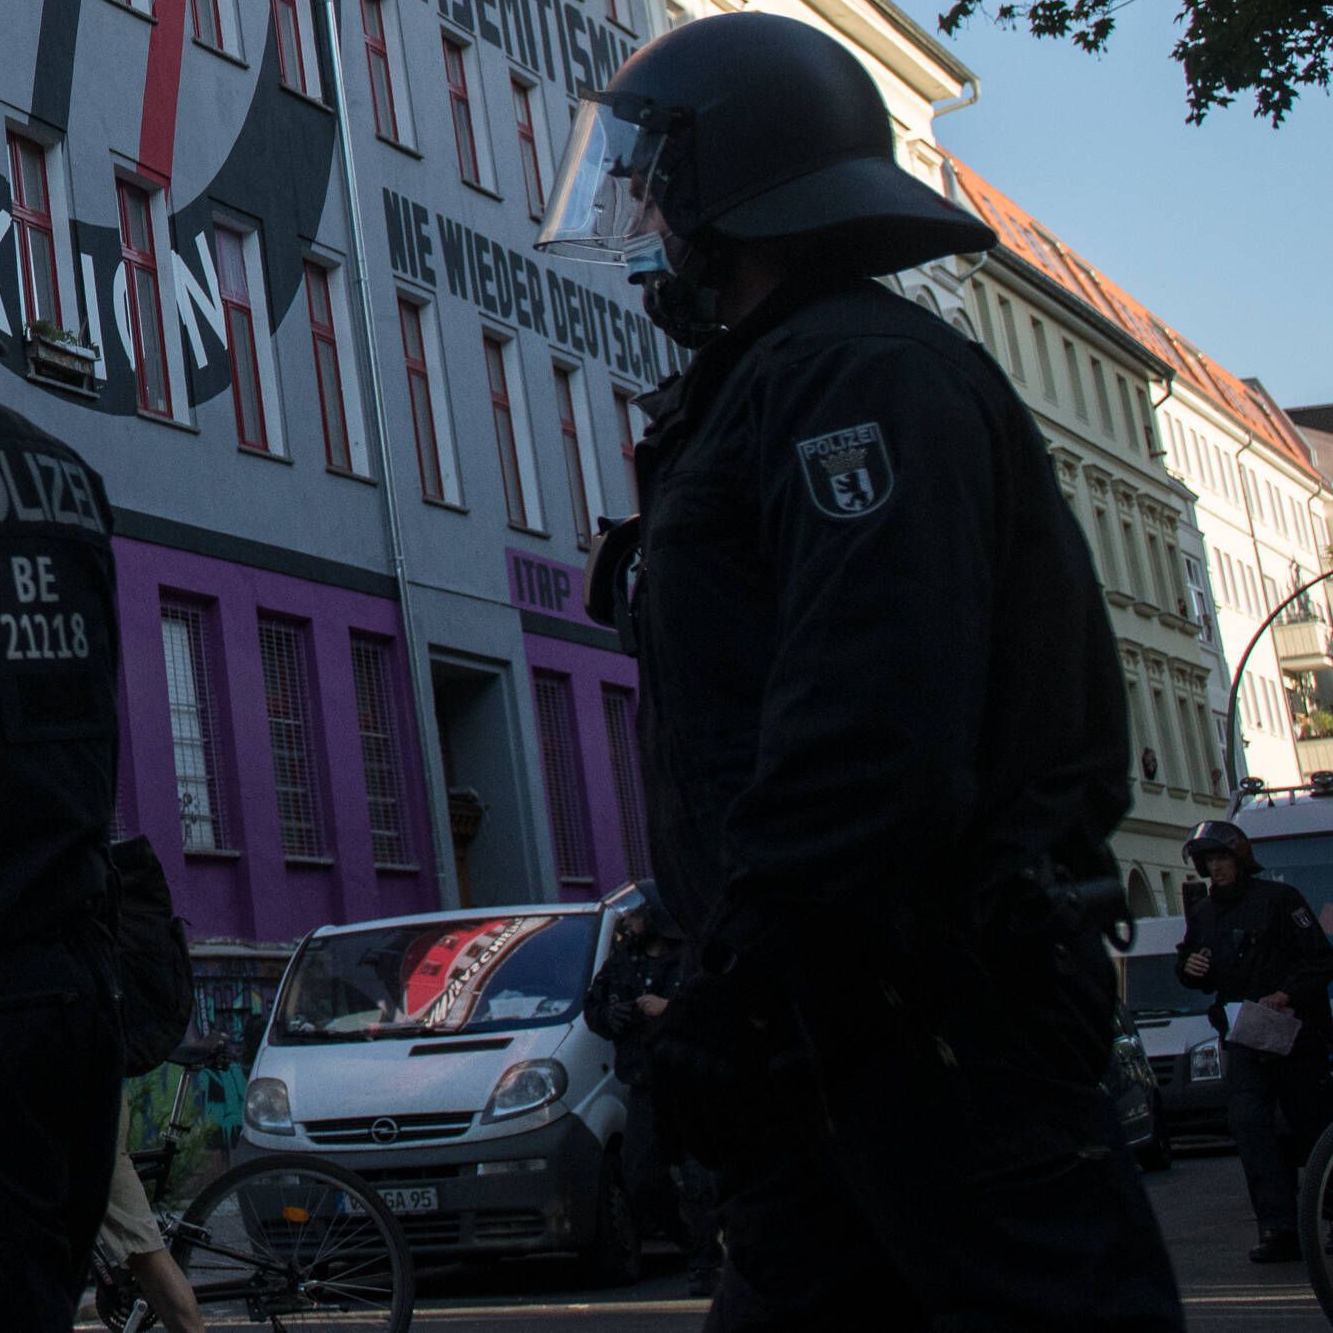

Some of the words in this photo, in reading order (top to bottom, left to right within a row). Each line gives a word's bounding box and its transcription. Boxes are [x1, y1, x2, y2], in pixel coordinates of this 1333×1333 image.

[382, 187, 437, 286] NIE
[437, 213, 549, 339] WIEDER
[803, 426, 878, 460] POLIZEI
[10, 556, 60, 603] BE
[0, 612, 90, 660] 21218
